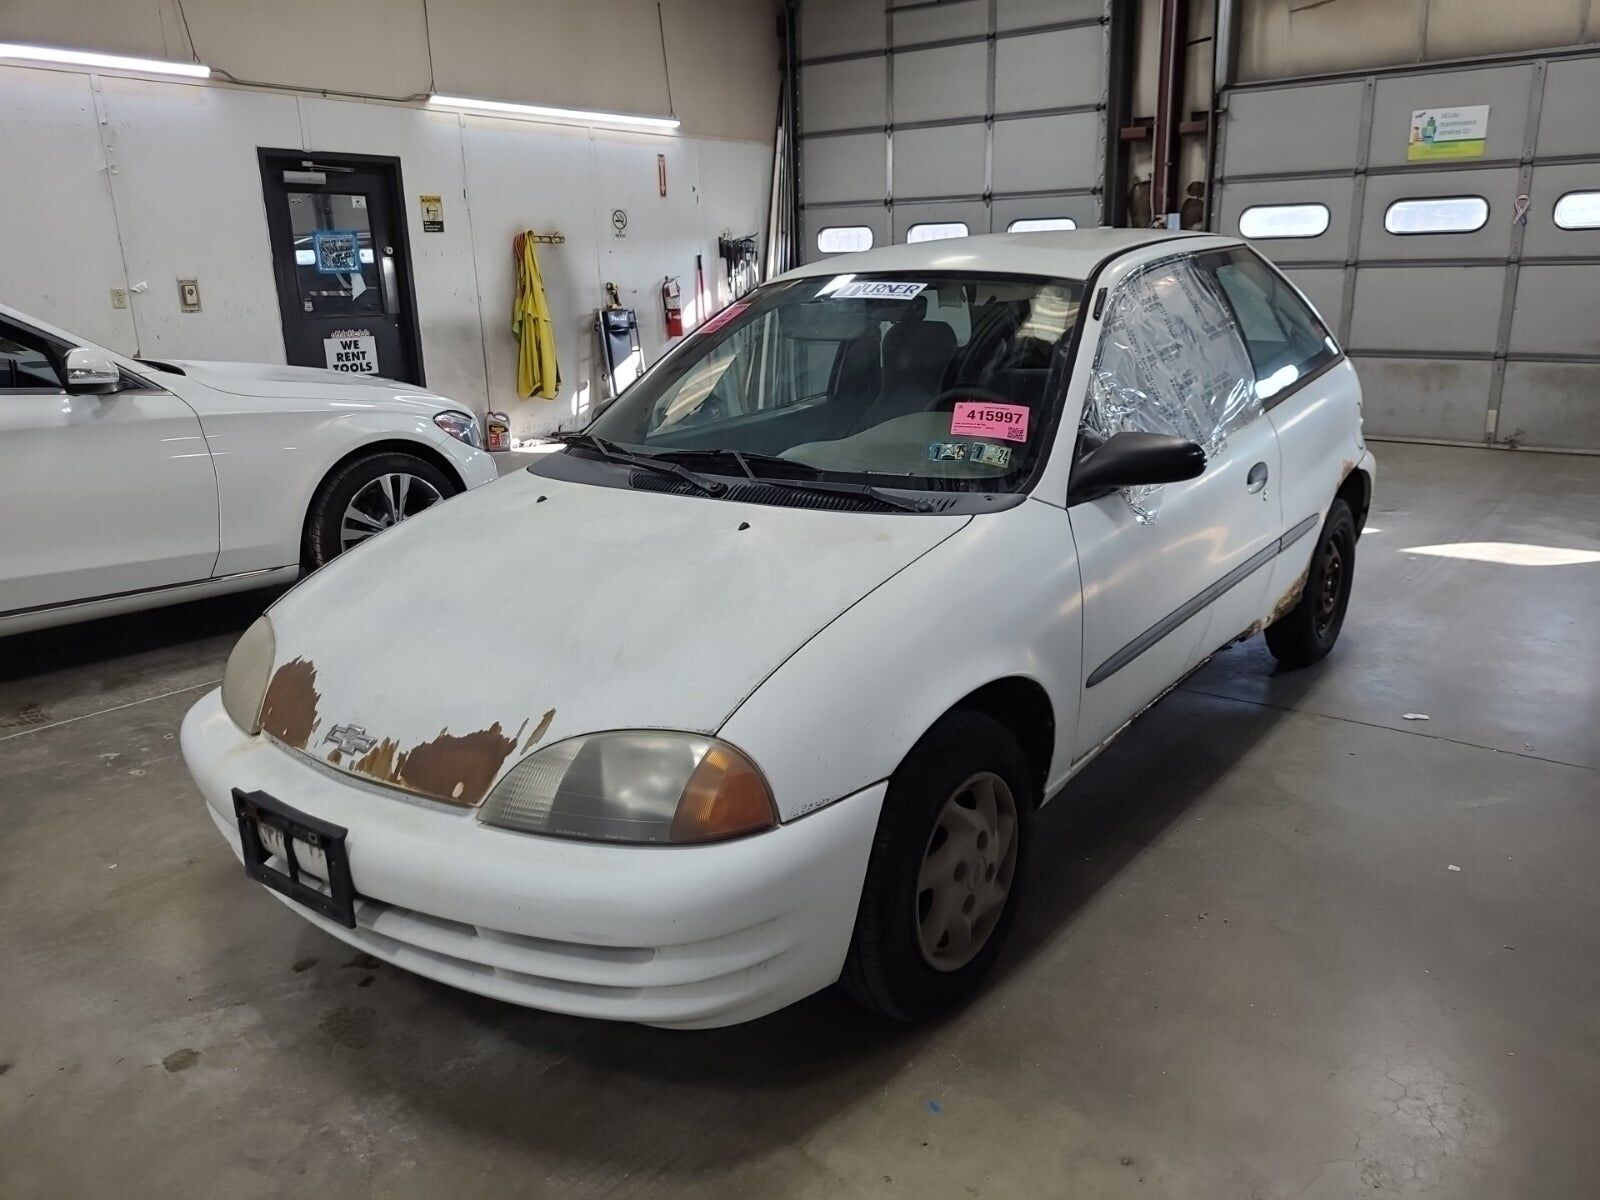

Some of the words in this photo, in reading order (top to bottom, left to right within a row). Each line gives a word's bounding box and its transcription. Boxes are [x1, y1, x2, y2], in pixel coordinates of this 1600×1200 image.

[340, 340, 360, 350] WE
[336, 351, 366, 362] RENT
[333, 362, 373, 373] TOOLS
[967, 410, 1023, 424] 415997
[998, 449, 1009, 464] 24
